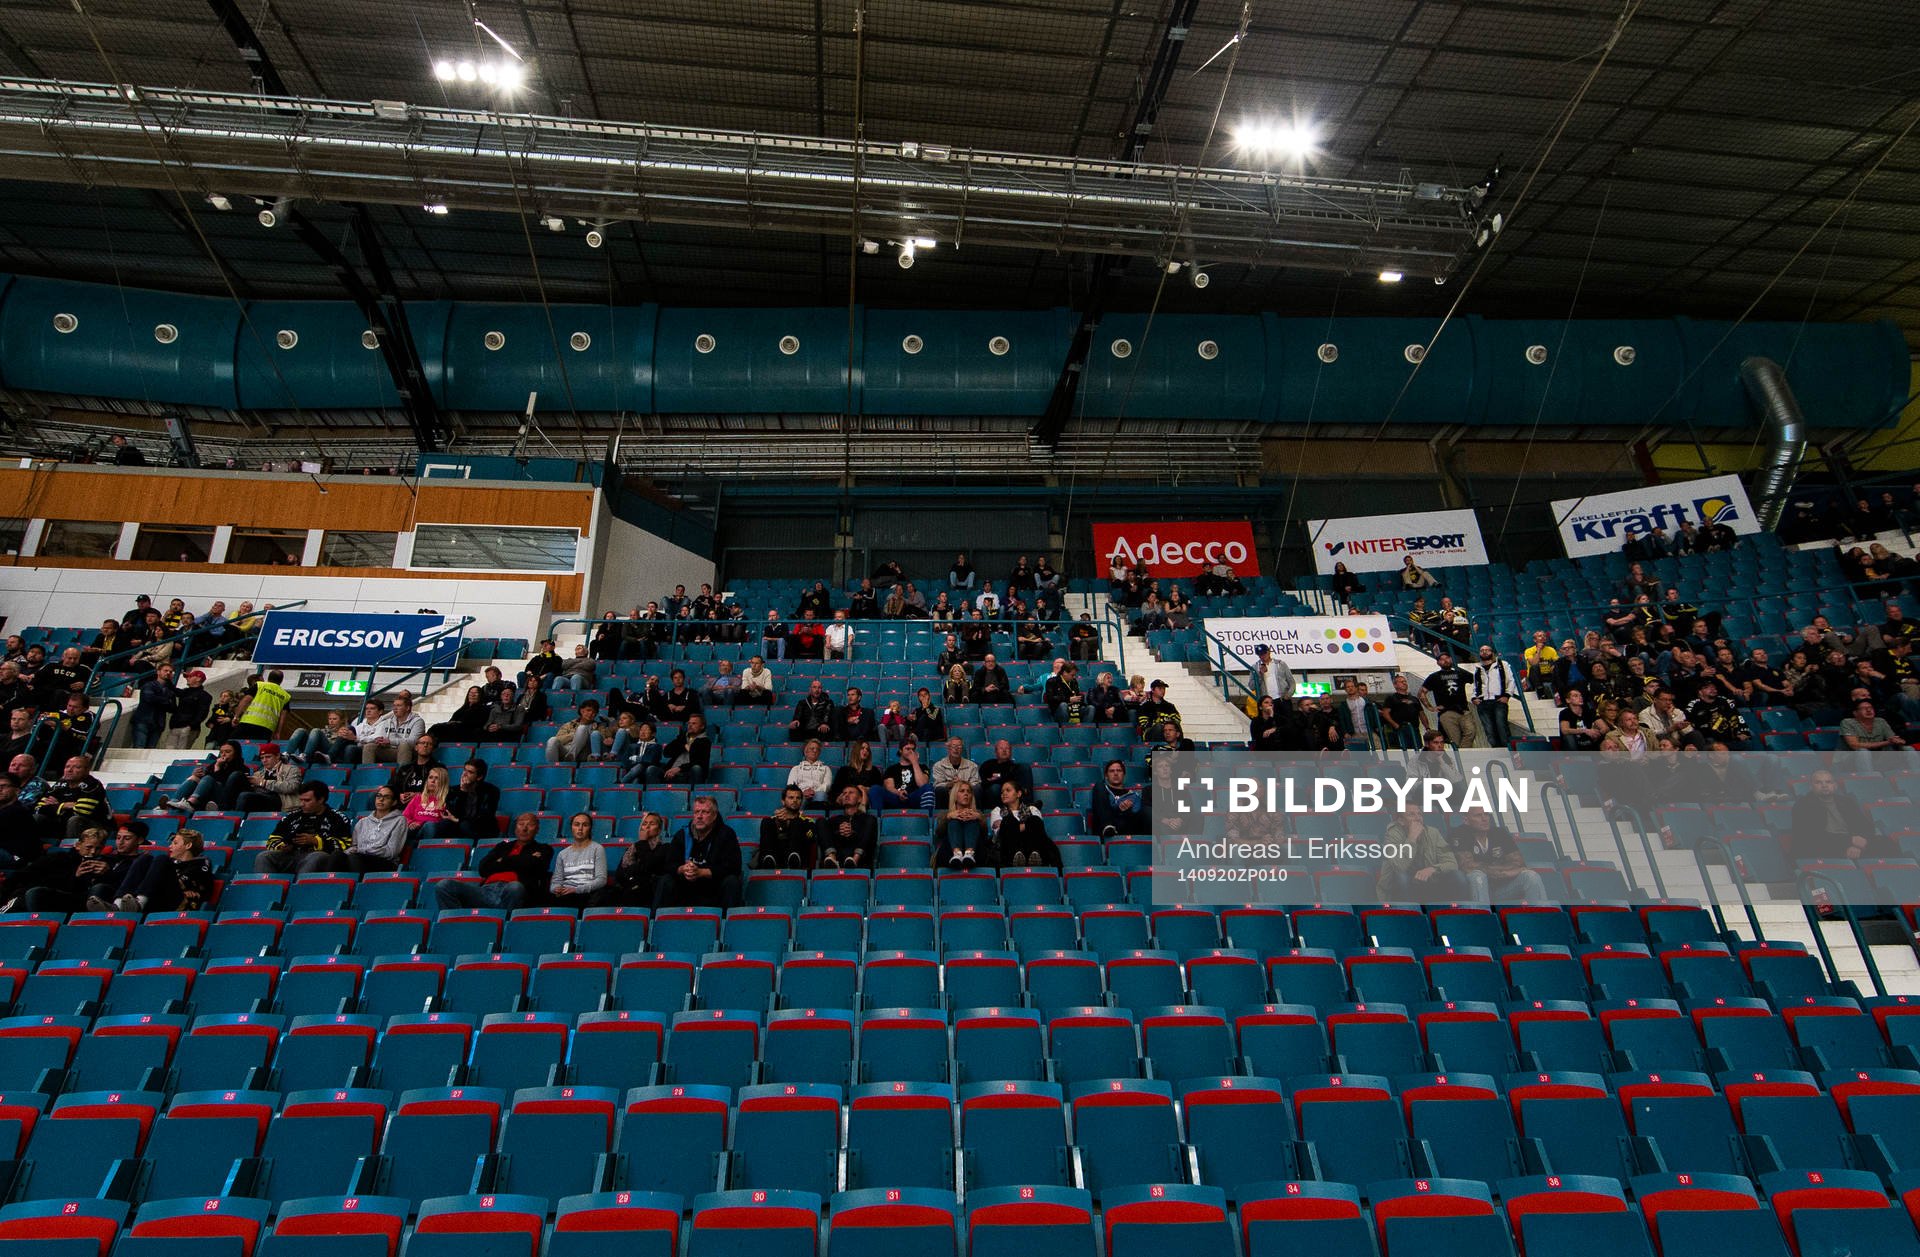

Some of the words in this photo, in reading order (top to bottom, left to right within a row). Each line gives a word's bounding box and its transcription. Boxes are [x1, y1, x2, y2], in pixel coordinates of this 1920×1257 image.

[1570, 507, 1646, 522] SKELLEFTEÅ
[1573, 504, 1688, 542] kraft
[1106, 534, 1247, 564] Adecco
[1348, 534, 1464, 554] INTERSPORT
[274, 628, 404, 648] ERICSSON
[1216, 630, 1298, 642] STOCKHOLM
[1269, 644, 1324, 655] ARENAS
[895, 1083, 904, 1092] 31
[1004, 1083, 1016, 1092] 32
[1111, 1081, 1122, 1091] 33
[1222, 1079, 1232, 1088] 34
[451, 1090, 462, 1098] 27
[674, 1088, 683, 1096] 29
[786, 1086, 795, 1095] 30
[1548, 1177, 1560, 1186] 36
[1679, 1175, 1689, 1184] 37
[1152, 1185, 1163, 1197] 33
[1288, 1184, 1298, 1193] 34
[1417, 1181, 1428, 1191] 35
[754, 1192, 765, 1202] 30
[888, 1190, 899, 1200] 31
[1022, 1187, 1032, 1198] 32
[482, 1197, 493, 1207] 28
[618, 1193, 629, 1204] 29
[64, 1203, 77, 1213] 25
[206, 1200, 219, 1210] 26
[345, 1199, 358, 1209] 27
